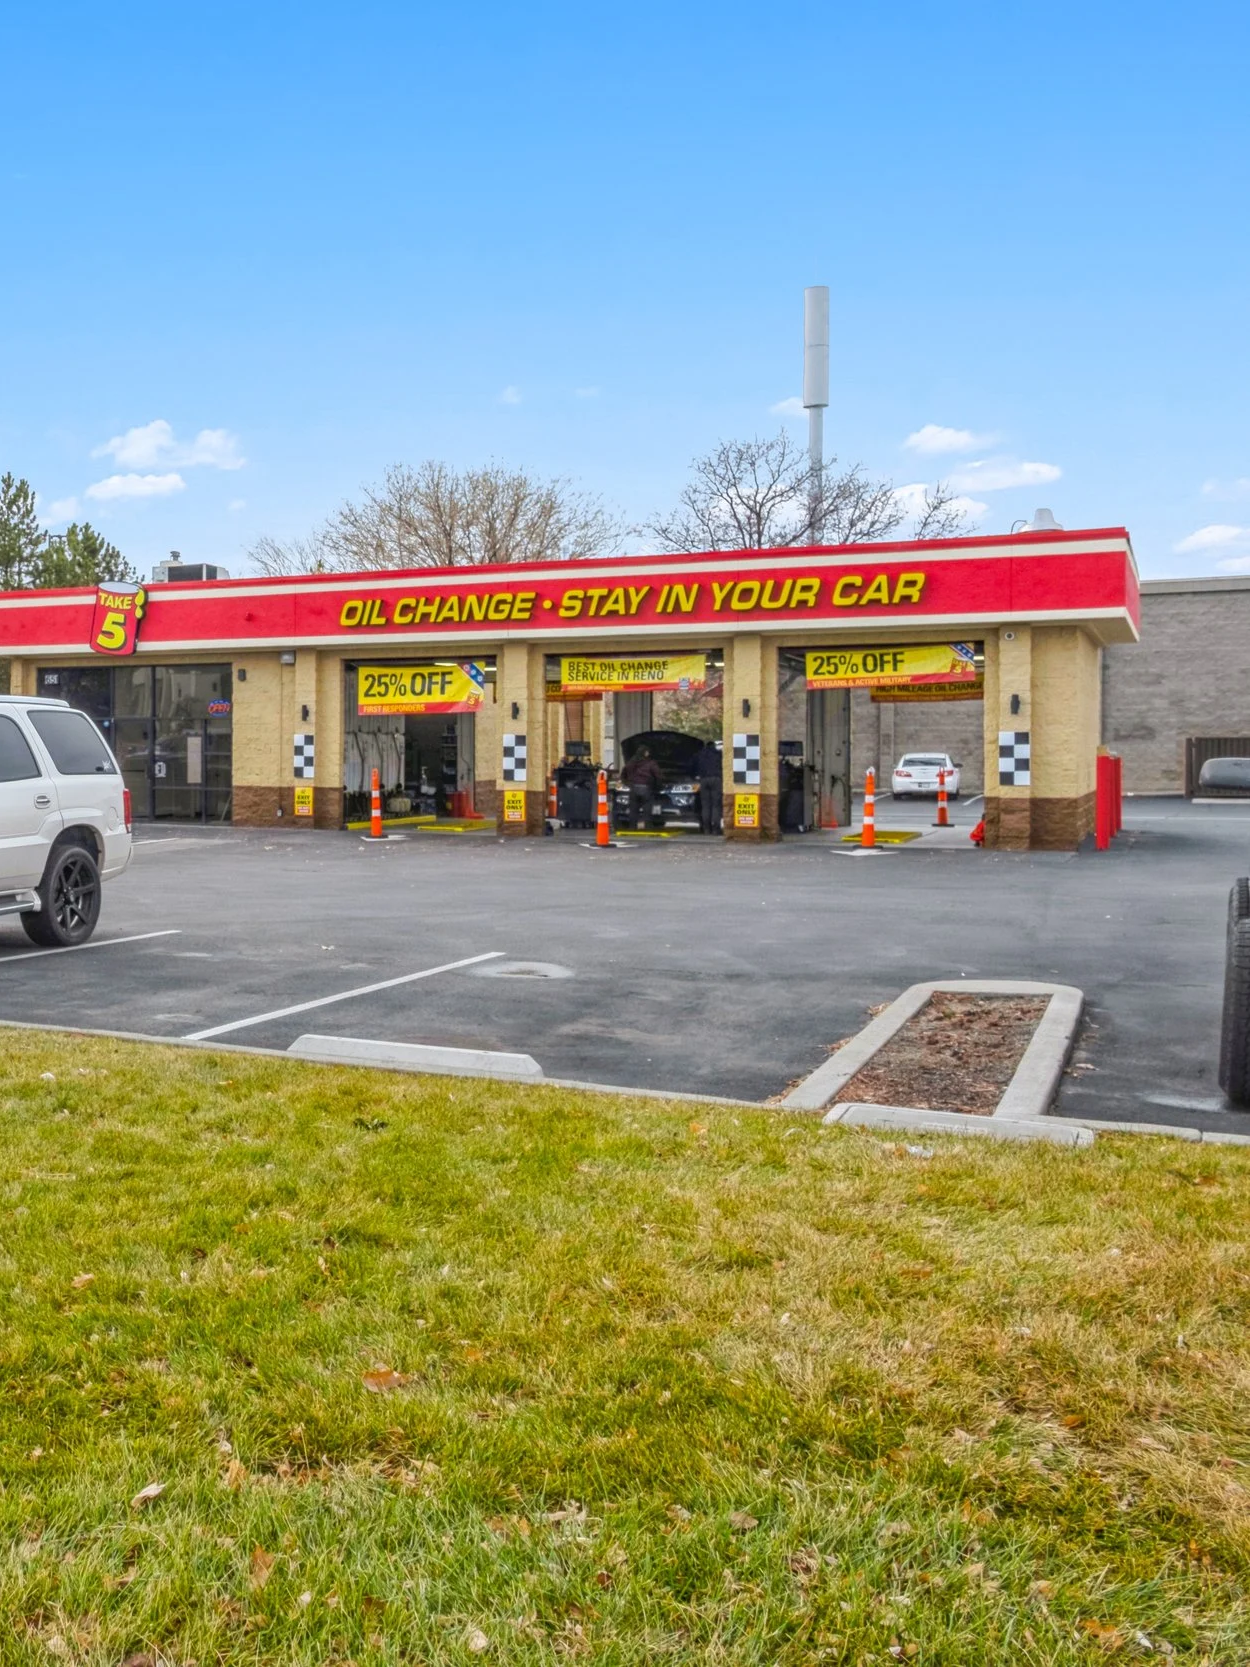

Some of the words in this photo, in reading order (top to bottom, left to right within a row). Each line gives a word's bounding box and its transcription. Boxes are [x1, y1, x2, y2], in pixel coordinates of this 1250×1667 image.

[98, 592, 133, 610] TAKE
[340, 600, 387, 626] OIL
[393, 591, 536, 625] CHANGE
[558, 586, 649, 618] STAY
[656, 585, 699, 613] IN
[712, 577, 821, 611] YOUR
[832, 572, 925, 607] CAR
[96, 611, 126, 650] 5
[568, 661, 595, 671] BEST
[599, 661, 615, 671] OIL
[620, 660, 669, 671] CHANGE
[812, 653, 859, 677] 25%
[862, 651, 905, 674] OFF
[568, 671, 613, 681] SERVICE
[617, 671, 626, 680] IN
[633, 669, 664, 680] RENO
[812, 680, 848, 688] VETERANS
[855, 678, 879, 686] ACTIVE
[363, 672, 407, 698] 25%
[410, 671, 454, 696] OFF
[363, 705, 382, 713] FIRST
[382, 703, 426, 713] RESPONDERS
